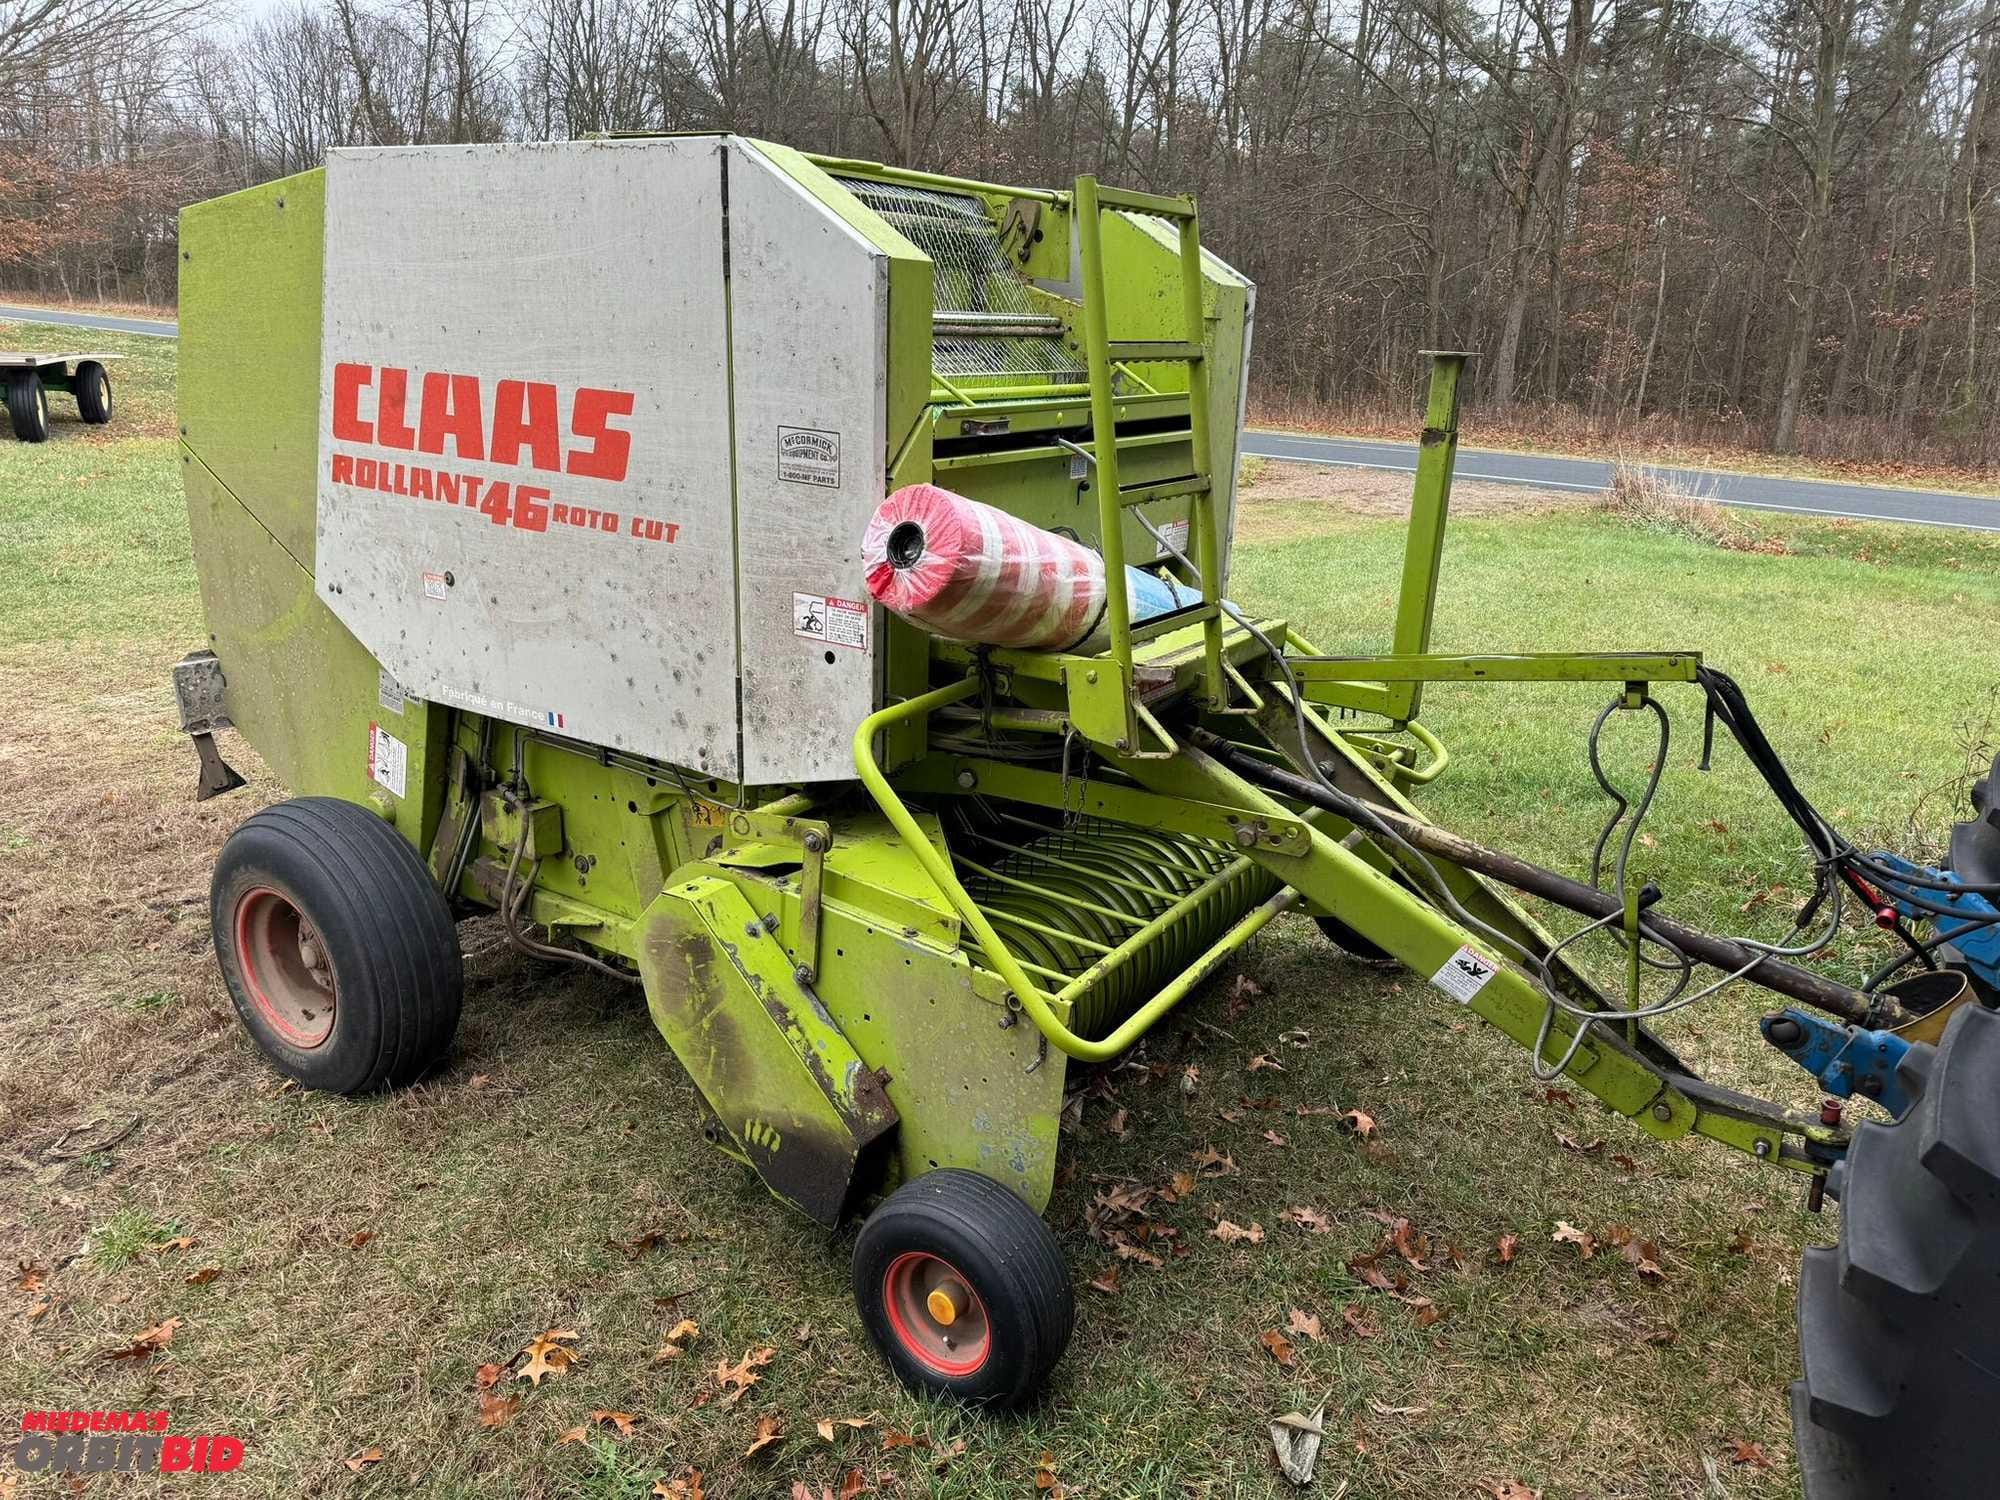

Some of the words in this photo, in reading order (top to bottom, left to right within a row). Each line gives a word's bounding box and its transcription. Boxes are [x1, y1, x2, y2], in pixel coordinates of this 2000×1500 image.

[333, 362, 635, 482] CLAAS
[814, 475, 835, 484] PARTS
[553, 503, 619, 533] ROTO
[631, 517, 680, 544] CUT
[837, 600, 864, 611] DANGER
[490, 700, 503, 711] en
[507, 702, 544, 720] France
[1467, 948, 1497, 972] DANGER
